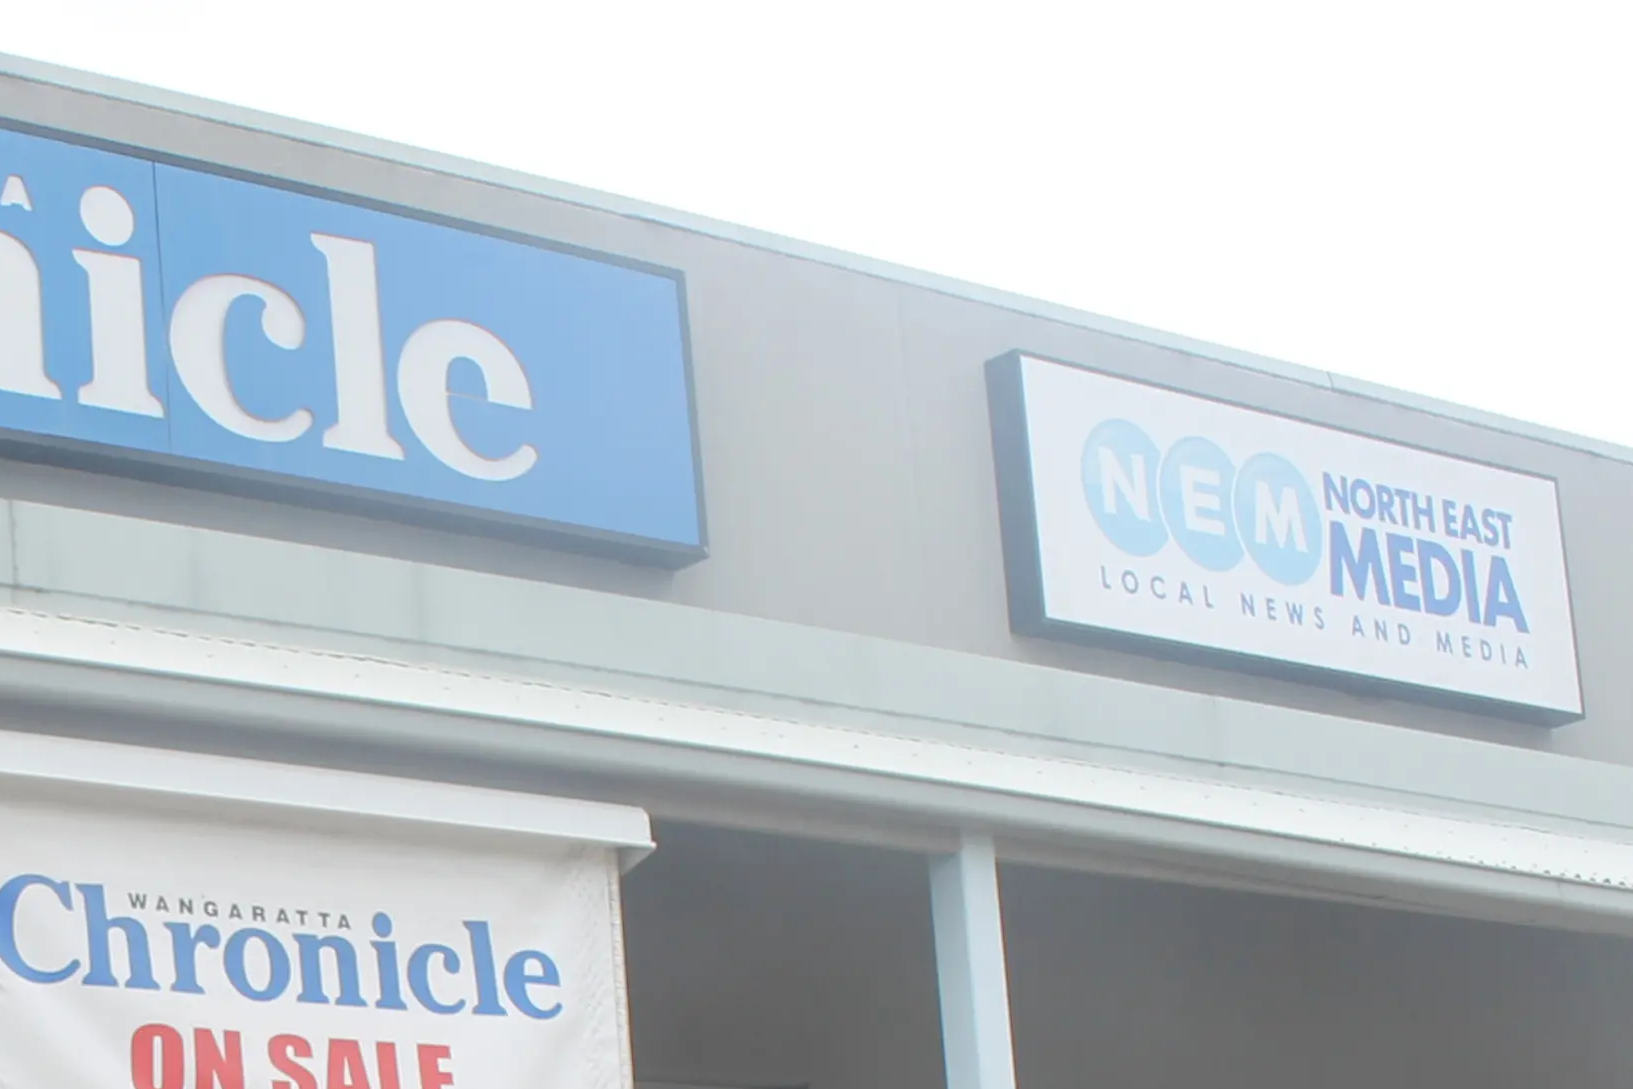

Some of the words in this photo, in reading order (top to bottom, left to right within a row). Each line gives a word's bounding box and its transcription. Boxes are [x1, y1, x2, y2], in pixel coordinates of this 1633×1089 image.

[1096, 446, 1308, 555] NEM
[1322, 471, 1435, 534] NORTH
[1443, 497, 1513, 550] EAST
[1100, 564, 1215, 609] LOCAL
[1240, 592, 1325, 630] NEWS
[1351, 614, 1411, 646] AND
[1436, 631, 1530, 669] MEDIA
[1329, 520, 1531, 635] MEDIA
[127, 892, 353, 931] WANGARATTA
